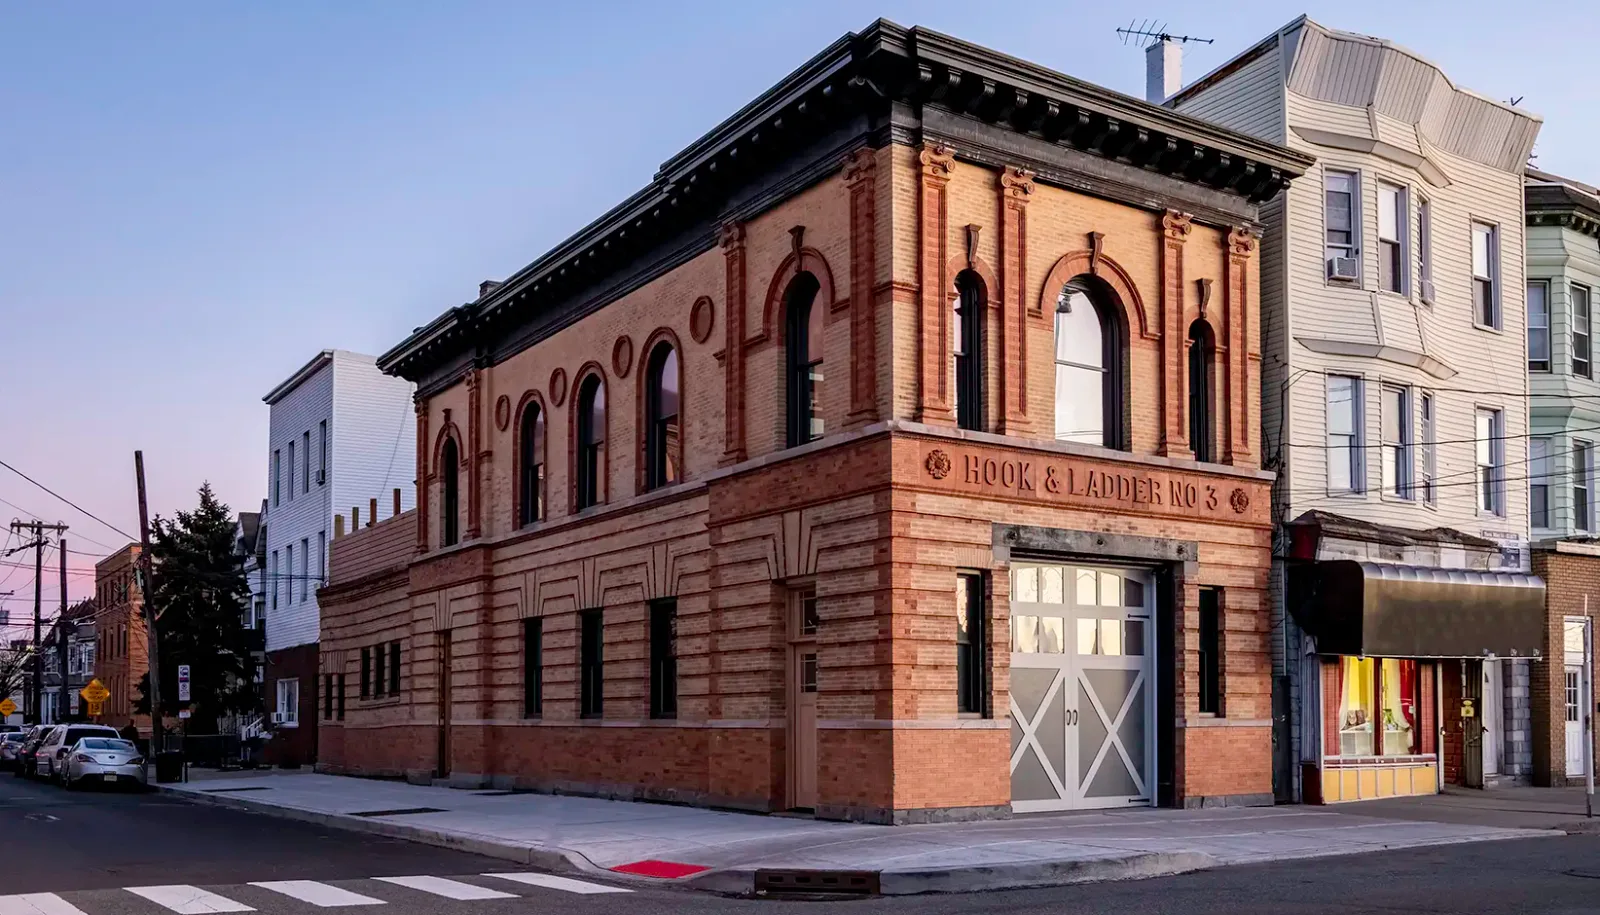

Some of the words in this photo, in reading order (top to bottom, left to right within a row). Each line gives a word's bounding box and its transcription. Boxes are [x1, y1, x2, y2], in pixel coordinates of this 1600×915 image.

[964, 454, 1035, 491] HOOK
[1045, 465, 1060, 494] &
[1068, 467, 1163, 505] LADDER
[1169, 480, 1196, 508] NO
[1205, 485, 1218, 510] 3
